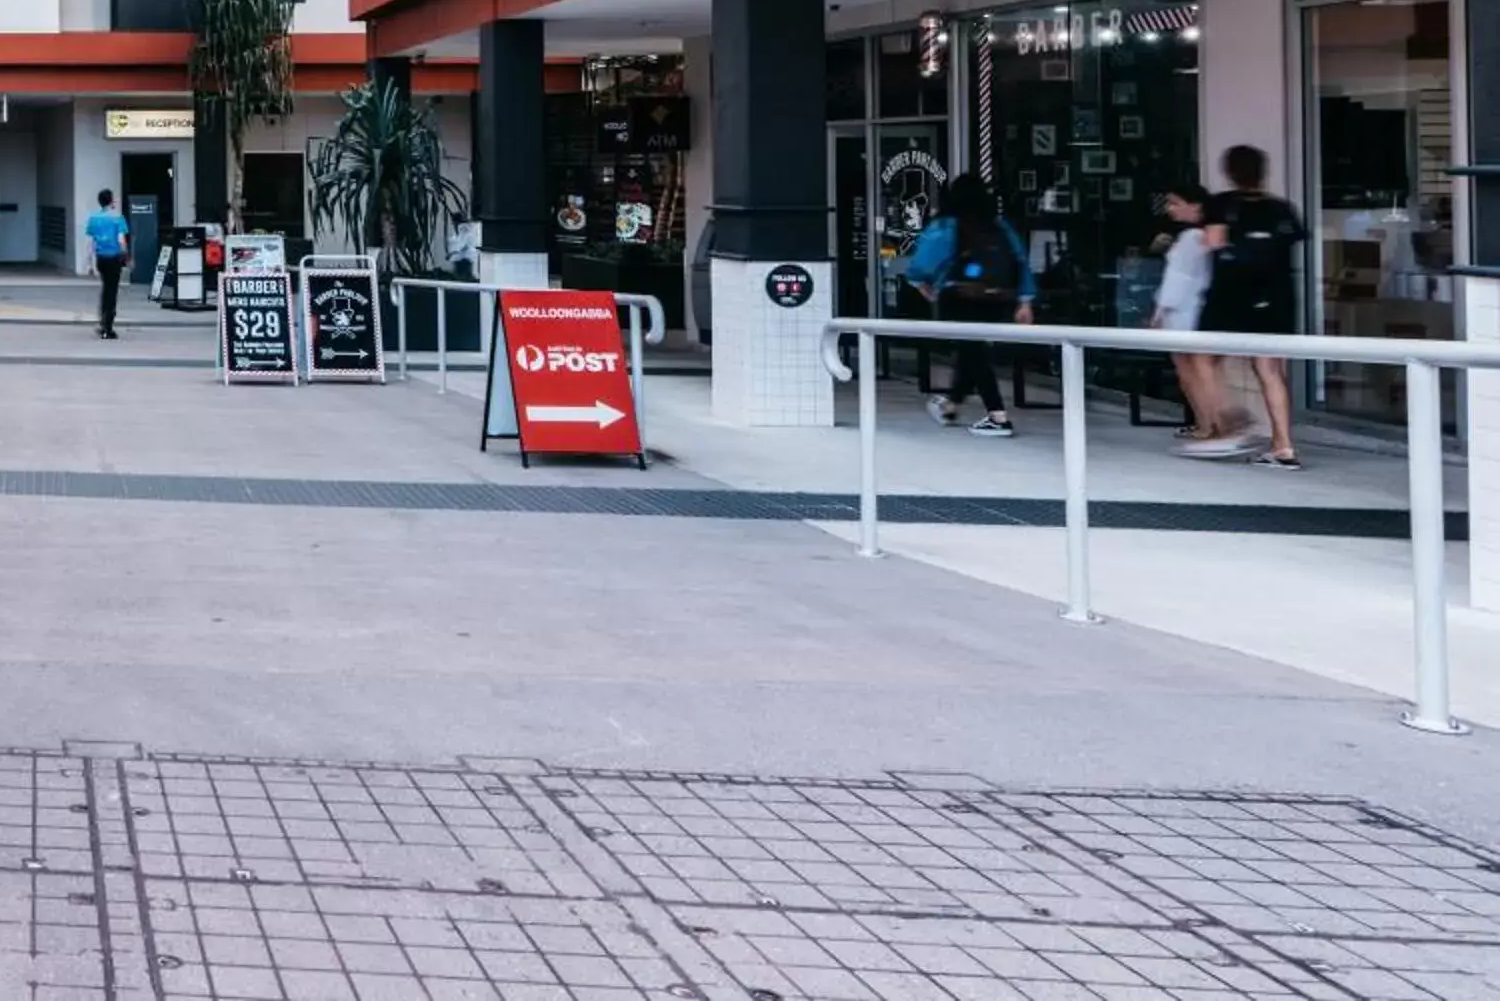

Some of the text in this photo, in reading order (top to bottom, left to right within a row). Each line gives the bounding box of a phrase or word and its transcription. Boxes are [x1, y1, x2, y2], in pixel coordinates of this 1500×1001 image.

[1017, 8, 1123, 55] BARBER
[145, 118, 194, 127] RECEPTION
[647, 133, 677, 148] ATM
[882, 150, 947, 185] BARBER PARLOUR
[232, 280, 278, 294] BARBER
[509, 306, 613, 319] WOOLLOONGABBA
[234, 308, 280, 339] $29
[548, 352, 619, 372] POST
